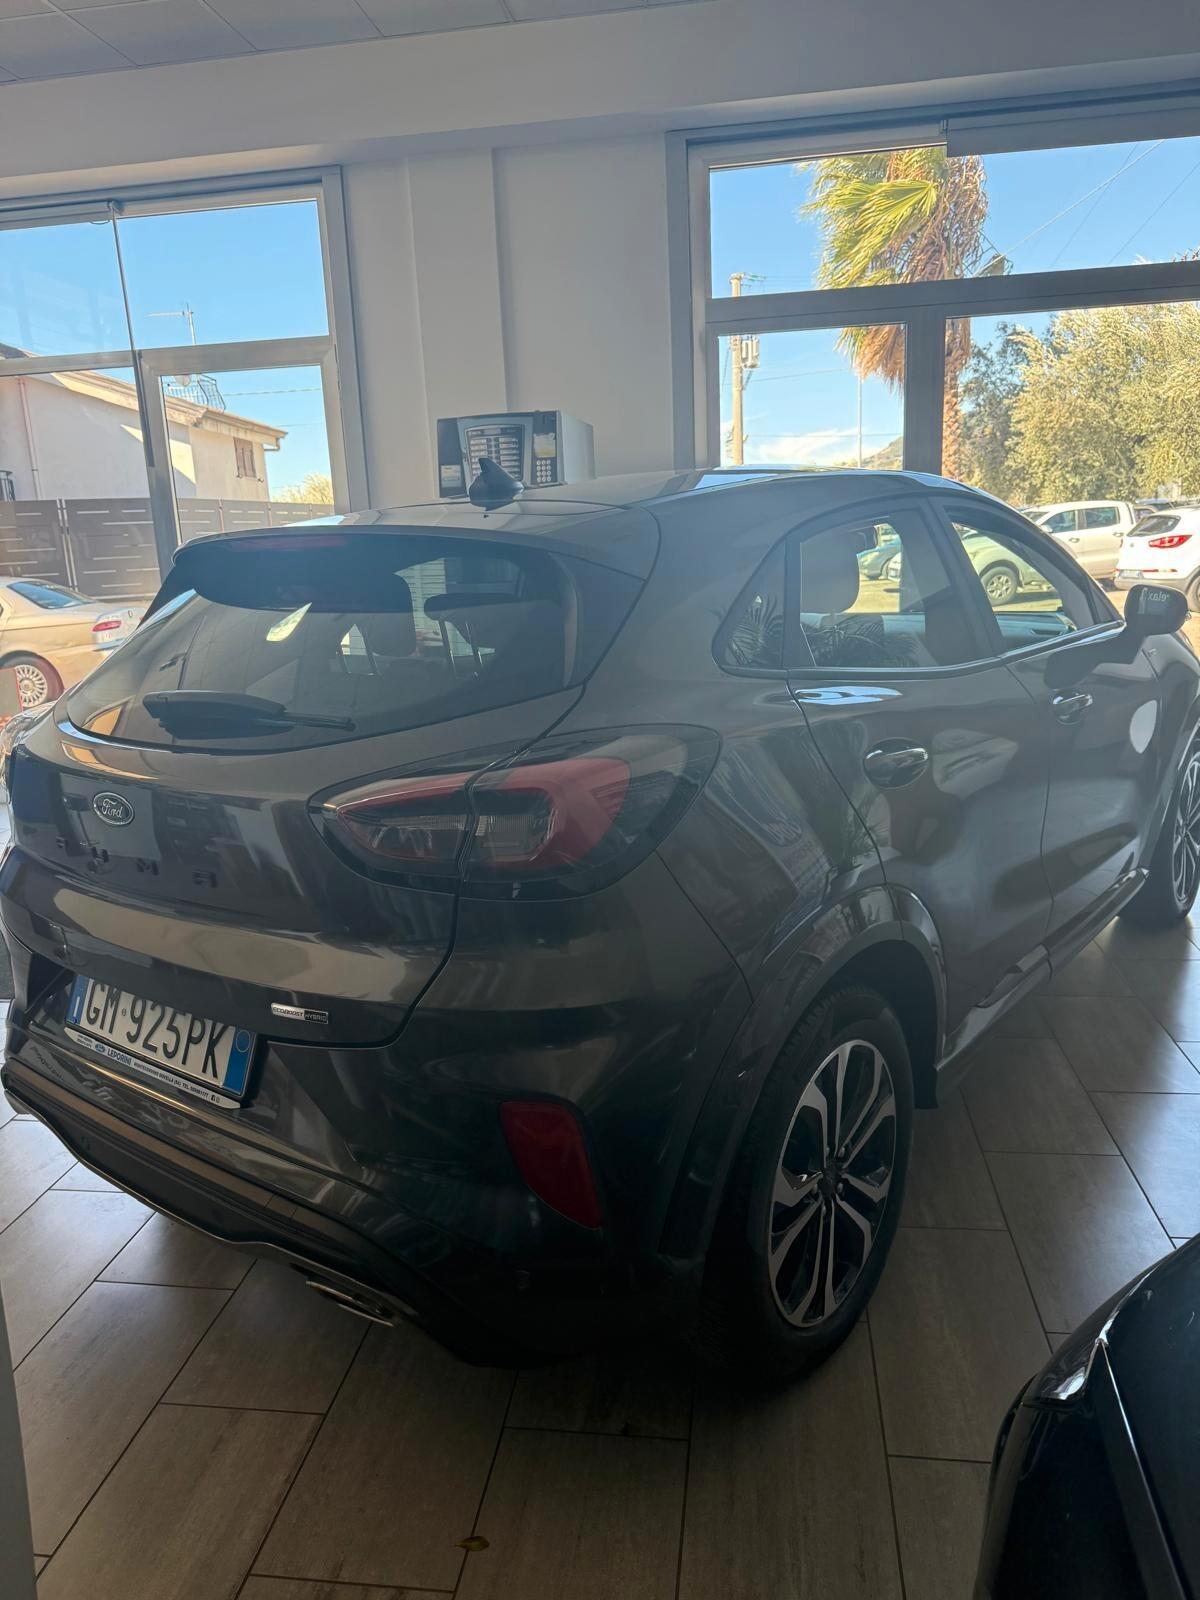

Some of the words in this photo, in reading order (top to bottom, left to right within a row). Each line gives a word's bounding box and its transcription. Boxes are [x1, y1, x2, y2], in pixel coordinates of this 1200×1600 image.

[101, 798, 123, 819] Ford
[305, 1012, 327, 1022] HYBRID
[86, 982, 121, 1034] GM
[126, 995, 234, 1079] 925PK
